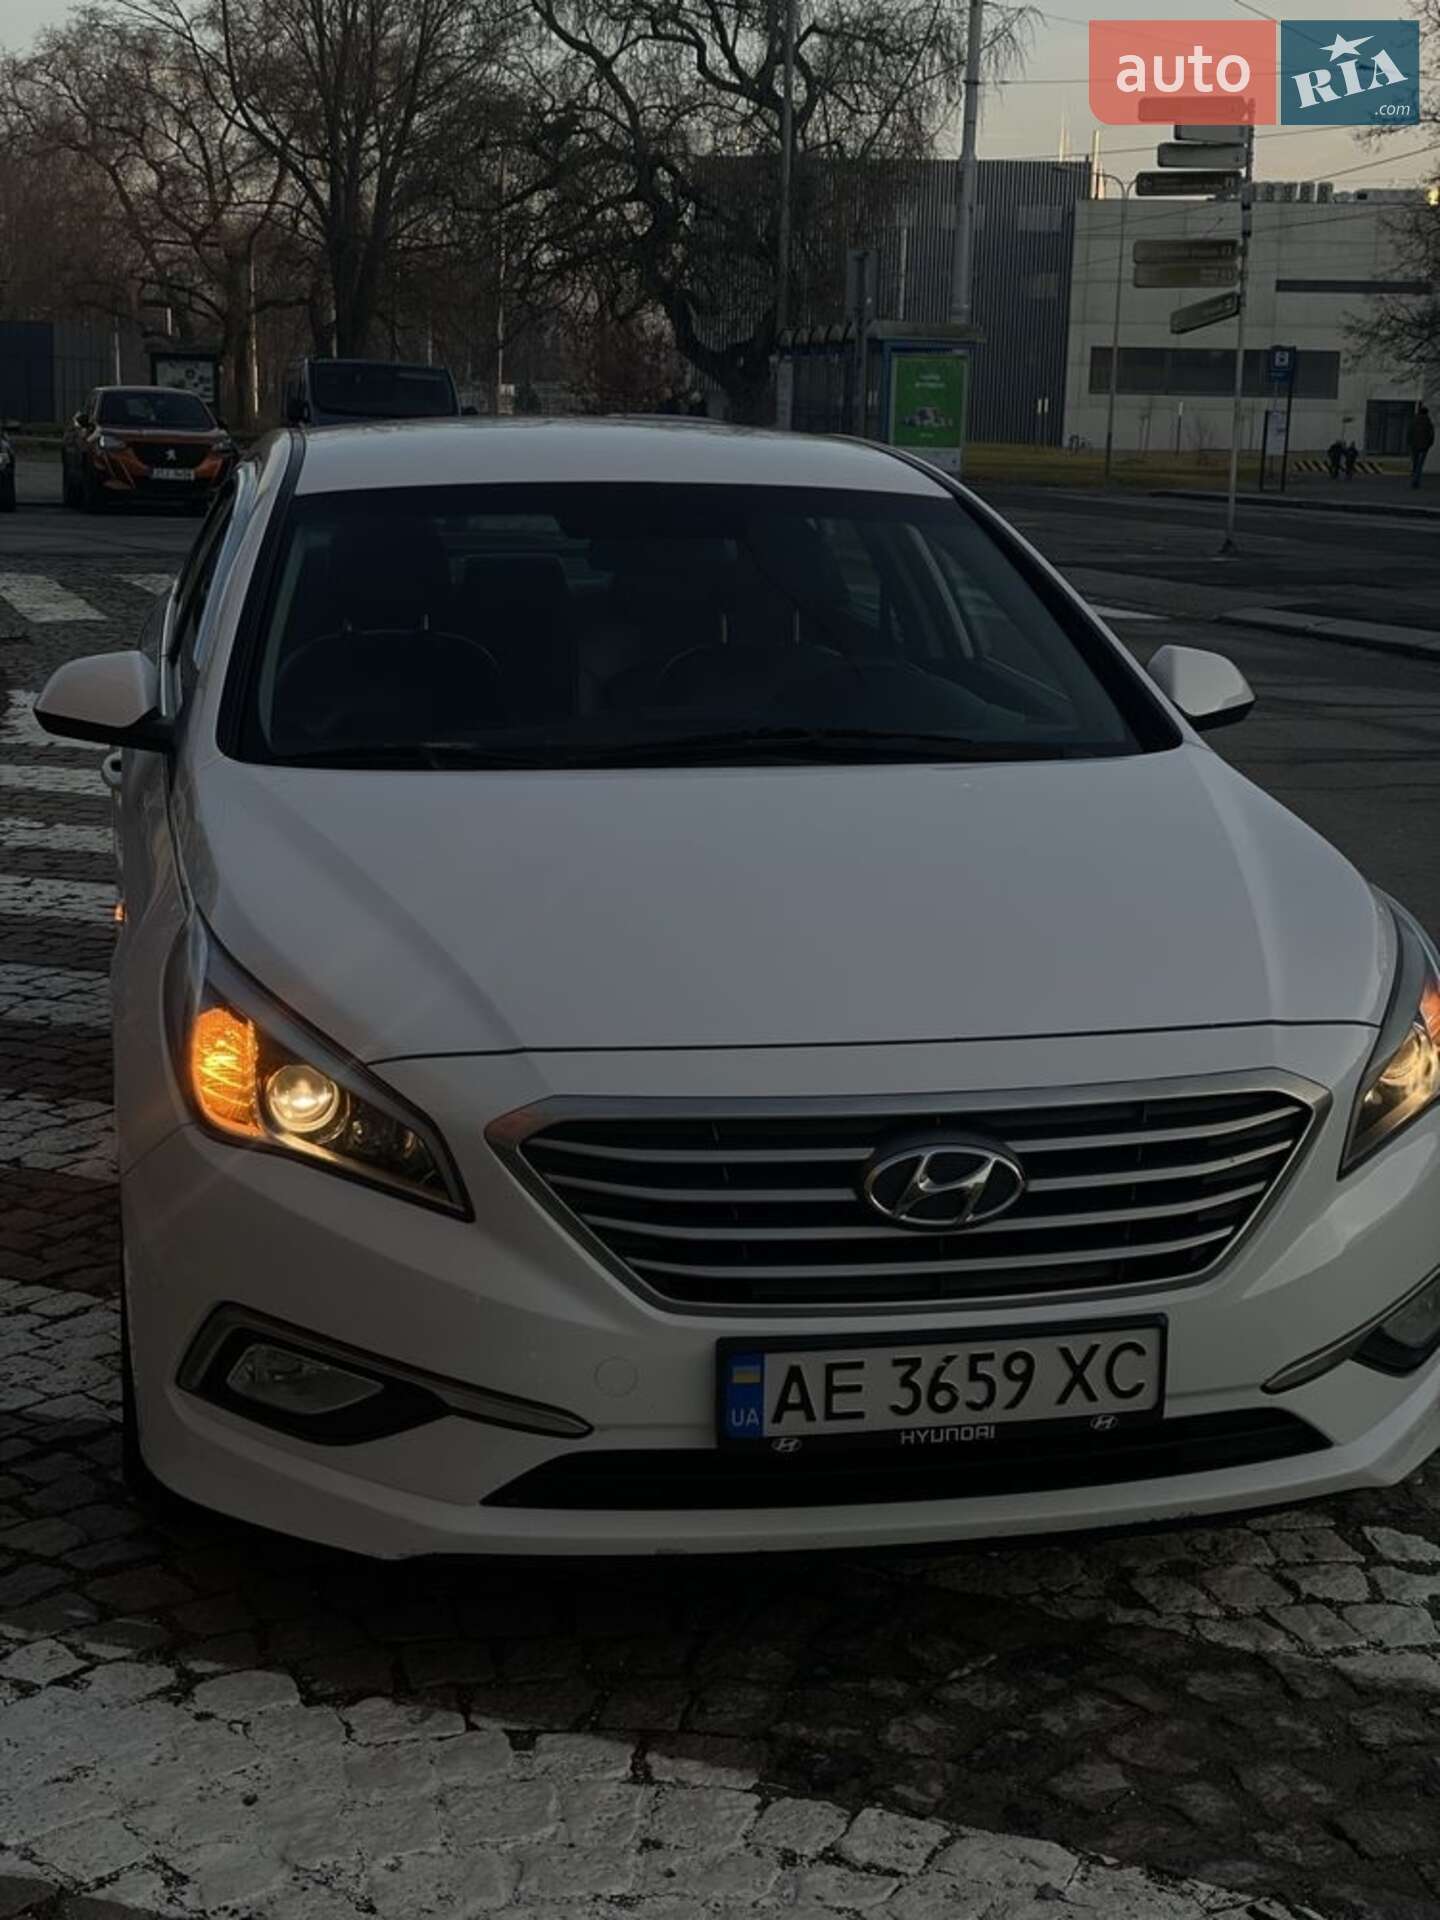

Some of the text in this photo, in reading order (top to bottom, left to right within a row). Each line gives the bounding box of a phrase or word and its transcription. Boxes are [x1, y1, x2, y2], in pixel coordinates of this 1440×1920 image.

[771, 1341, 1146, 1425] AE 3659 XC
[731, 1407, 760, 1427] UA
[900, 1424, 996, 1446] HYUNDAI
